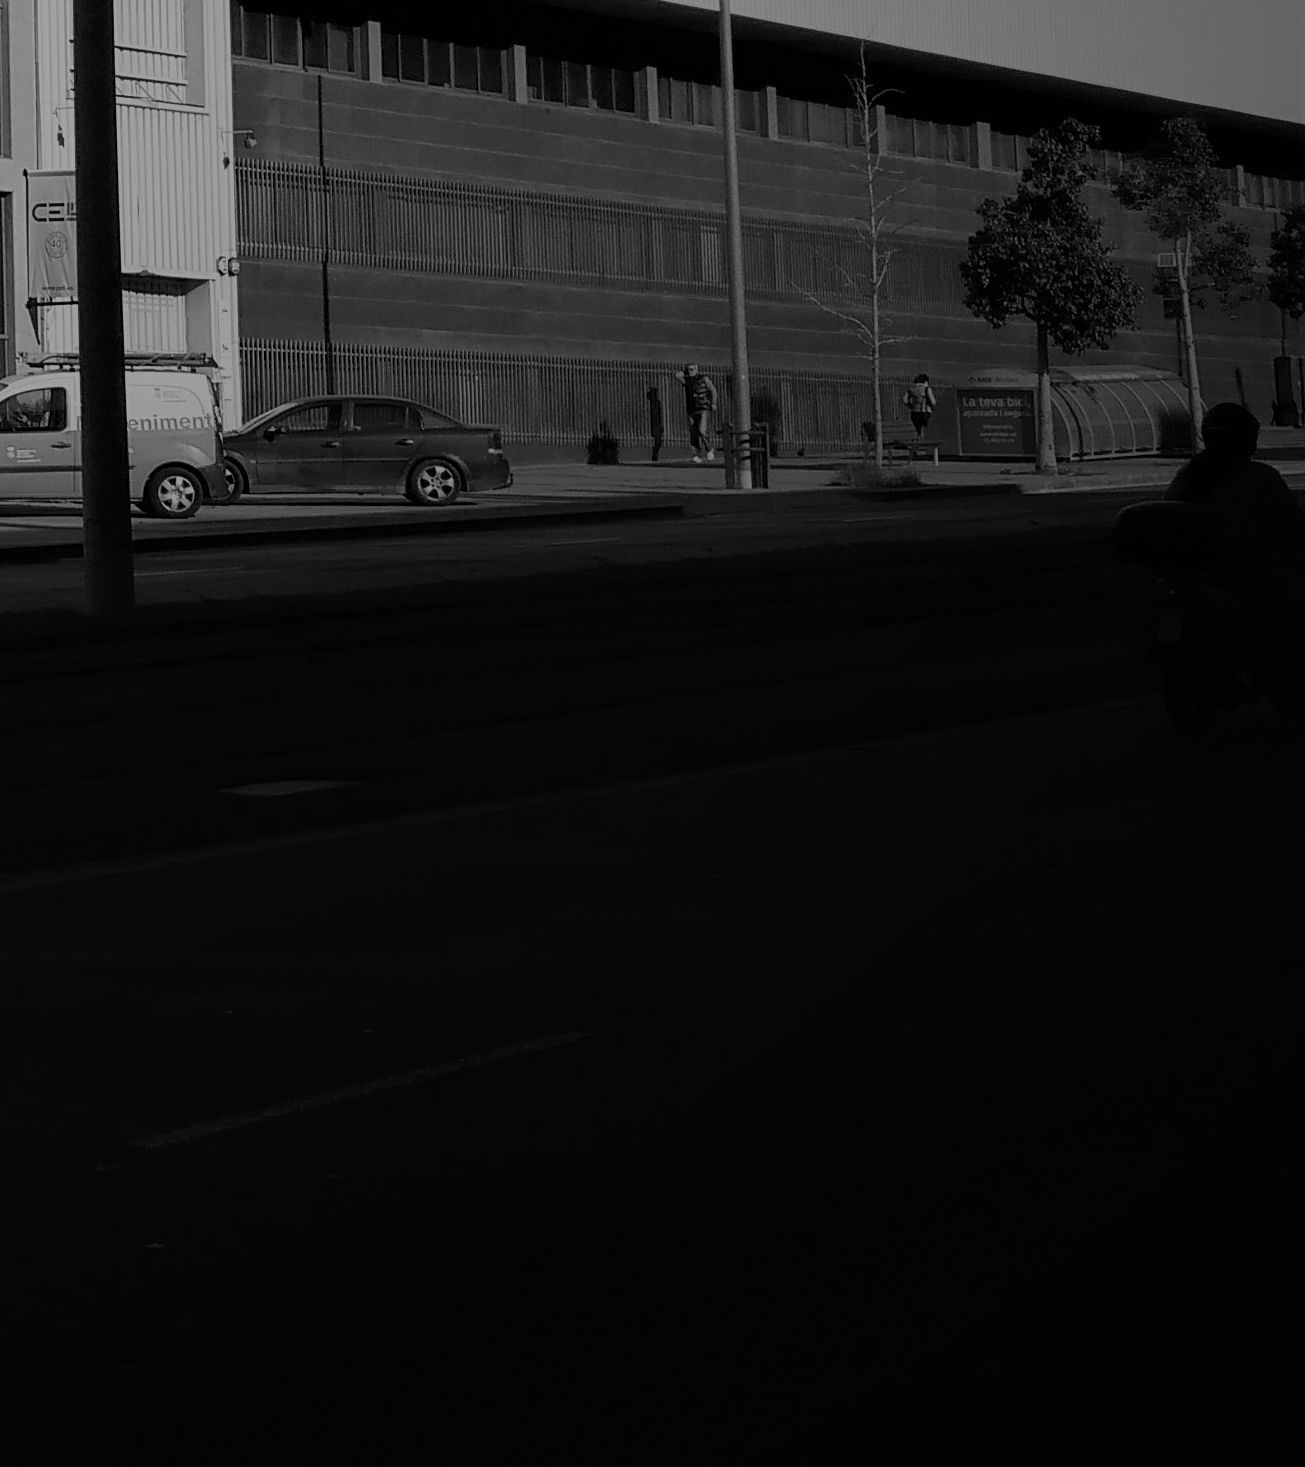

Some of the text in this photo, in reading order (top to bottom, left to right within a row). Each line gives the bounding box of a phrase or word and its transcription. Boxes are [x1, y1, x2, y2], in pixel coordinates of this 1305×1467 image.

[962, 397, 976, 407] La
[979, 397, 1004, 407] teva
[962, 409, 998, 418] aparcada
